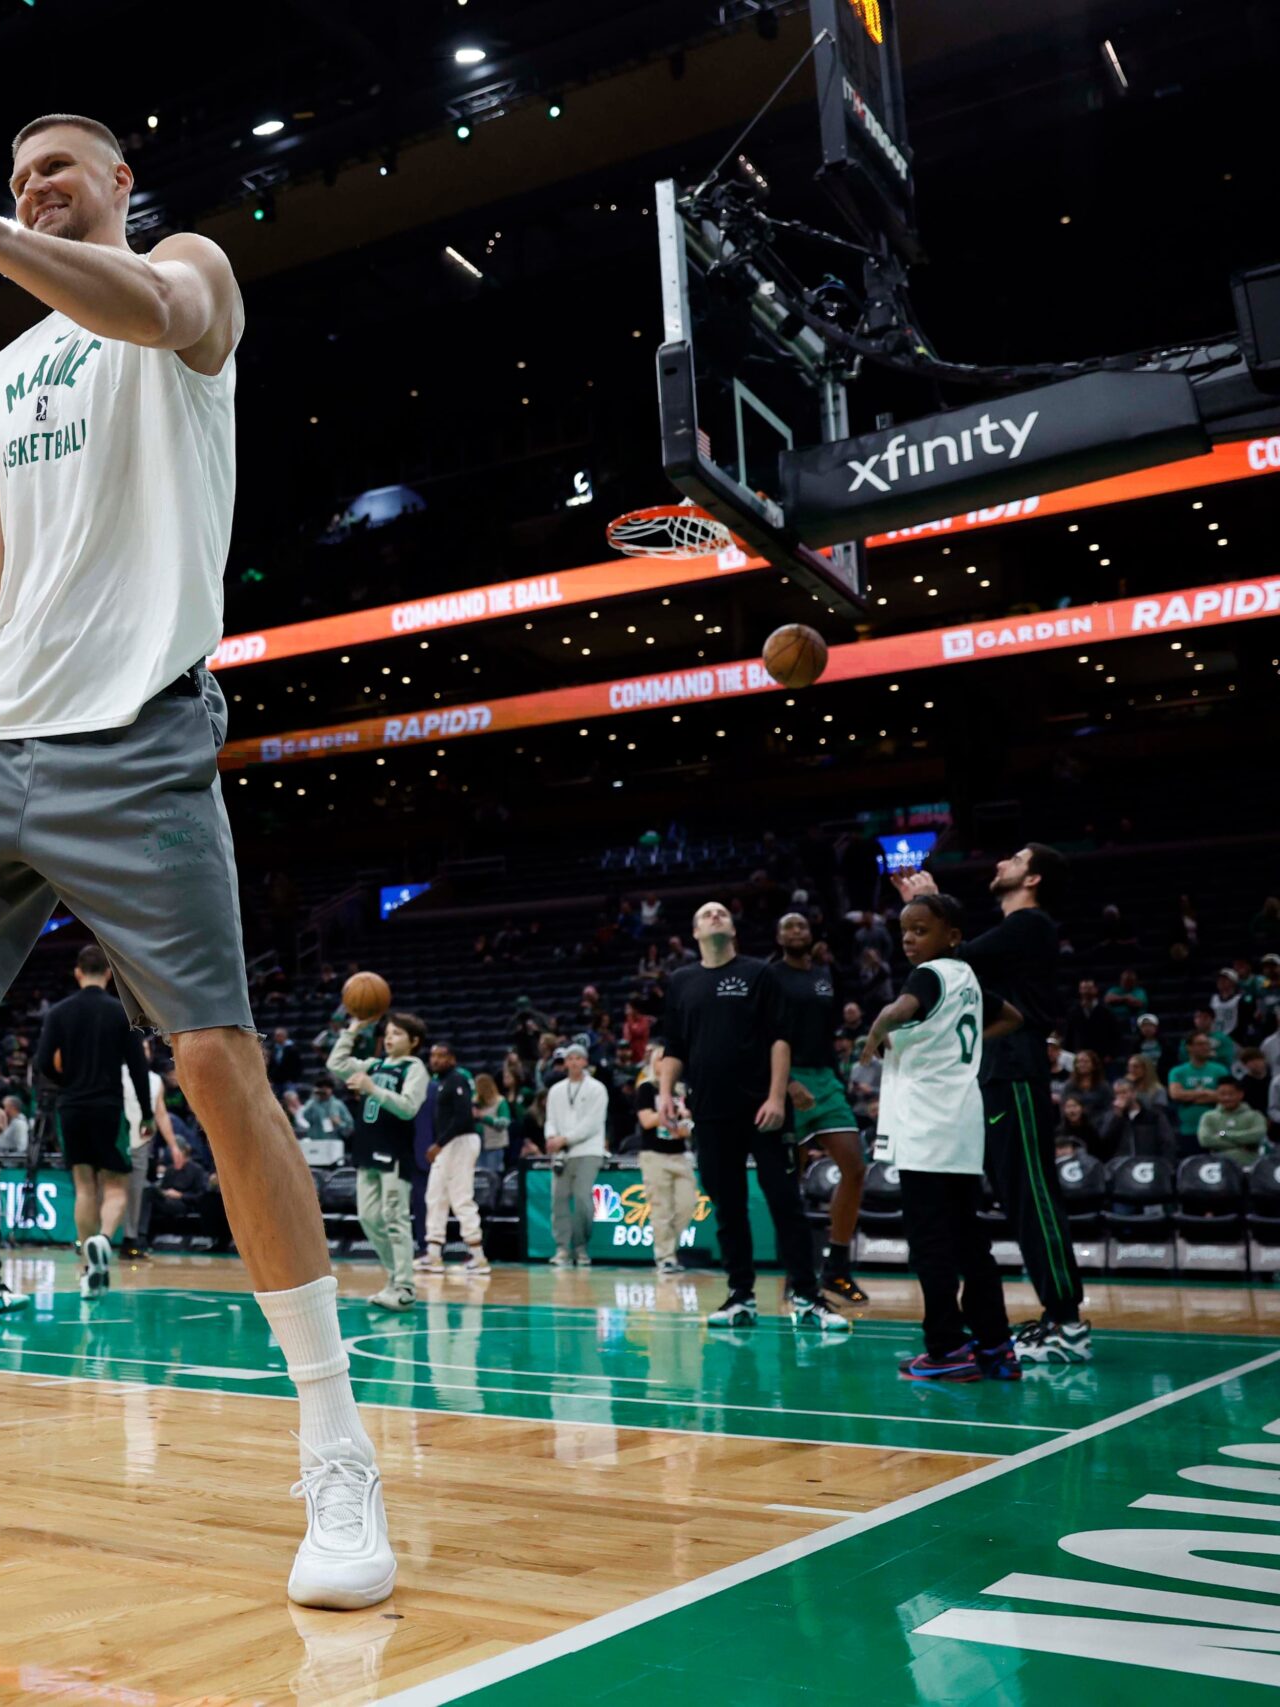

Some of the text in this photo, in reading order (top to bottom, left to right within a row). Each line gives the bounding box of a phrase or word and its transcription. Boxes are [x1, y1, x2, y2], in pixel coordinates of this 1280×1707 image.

[847, 411, 1040, 492] xfinity
[392, 592, 486, 632] COMMAND
[515, 577, 563, 608] BALL
[976, 615, 1092, 648] GARDEN
[609, 663, 778, 710] COMMAND THE BA
[283, 731, 359, 754] GARDEN
[956, 1013, 978, 1064] 0
[1061, 1160, 1083, 1182] G
[1132, 1162, 1154, 1183] G
[1199, 1162, 1222, 1184] G
[613, 1225, 696, 1247] BOSN
